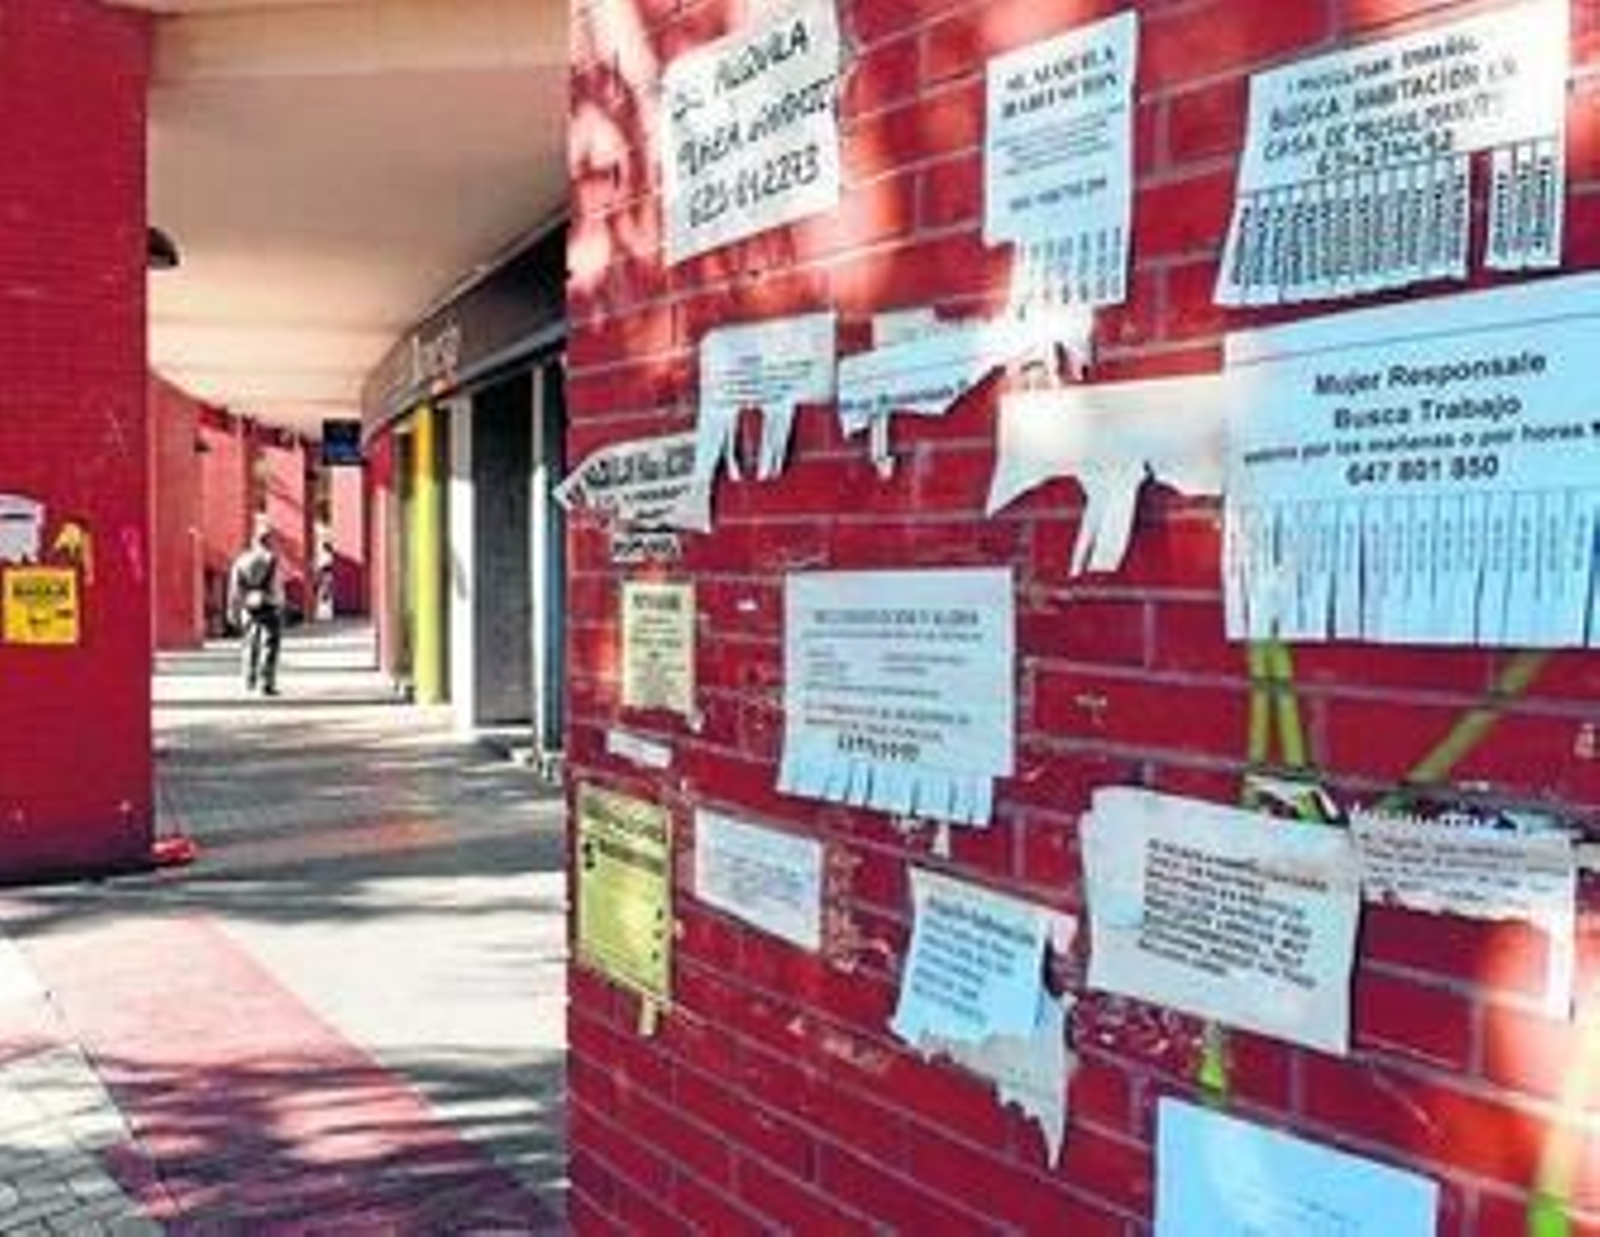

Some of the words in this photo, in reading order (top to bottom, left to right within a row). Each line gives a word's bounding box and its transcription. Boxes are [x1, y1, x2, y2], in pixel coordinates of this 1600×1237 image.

[1314, 371, 1381, 397] Mujer
[1387, 351, 1546, 389] Responsale
[1334, 406, 1411, 429] Busca
[1419, 394, 1522, 423] Trabajo
[1459, 432, 1475, 448] o
[1479, 427, 1515, 448] por
[1521, 422, 1584, 442] horas
[1345, 461, 1392, 486] 647
